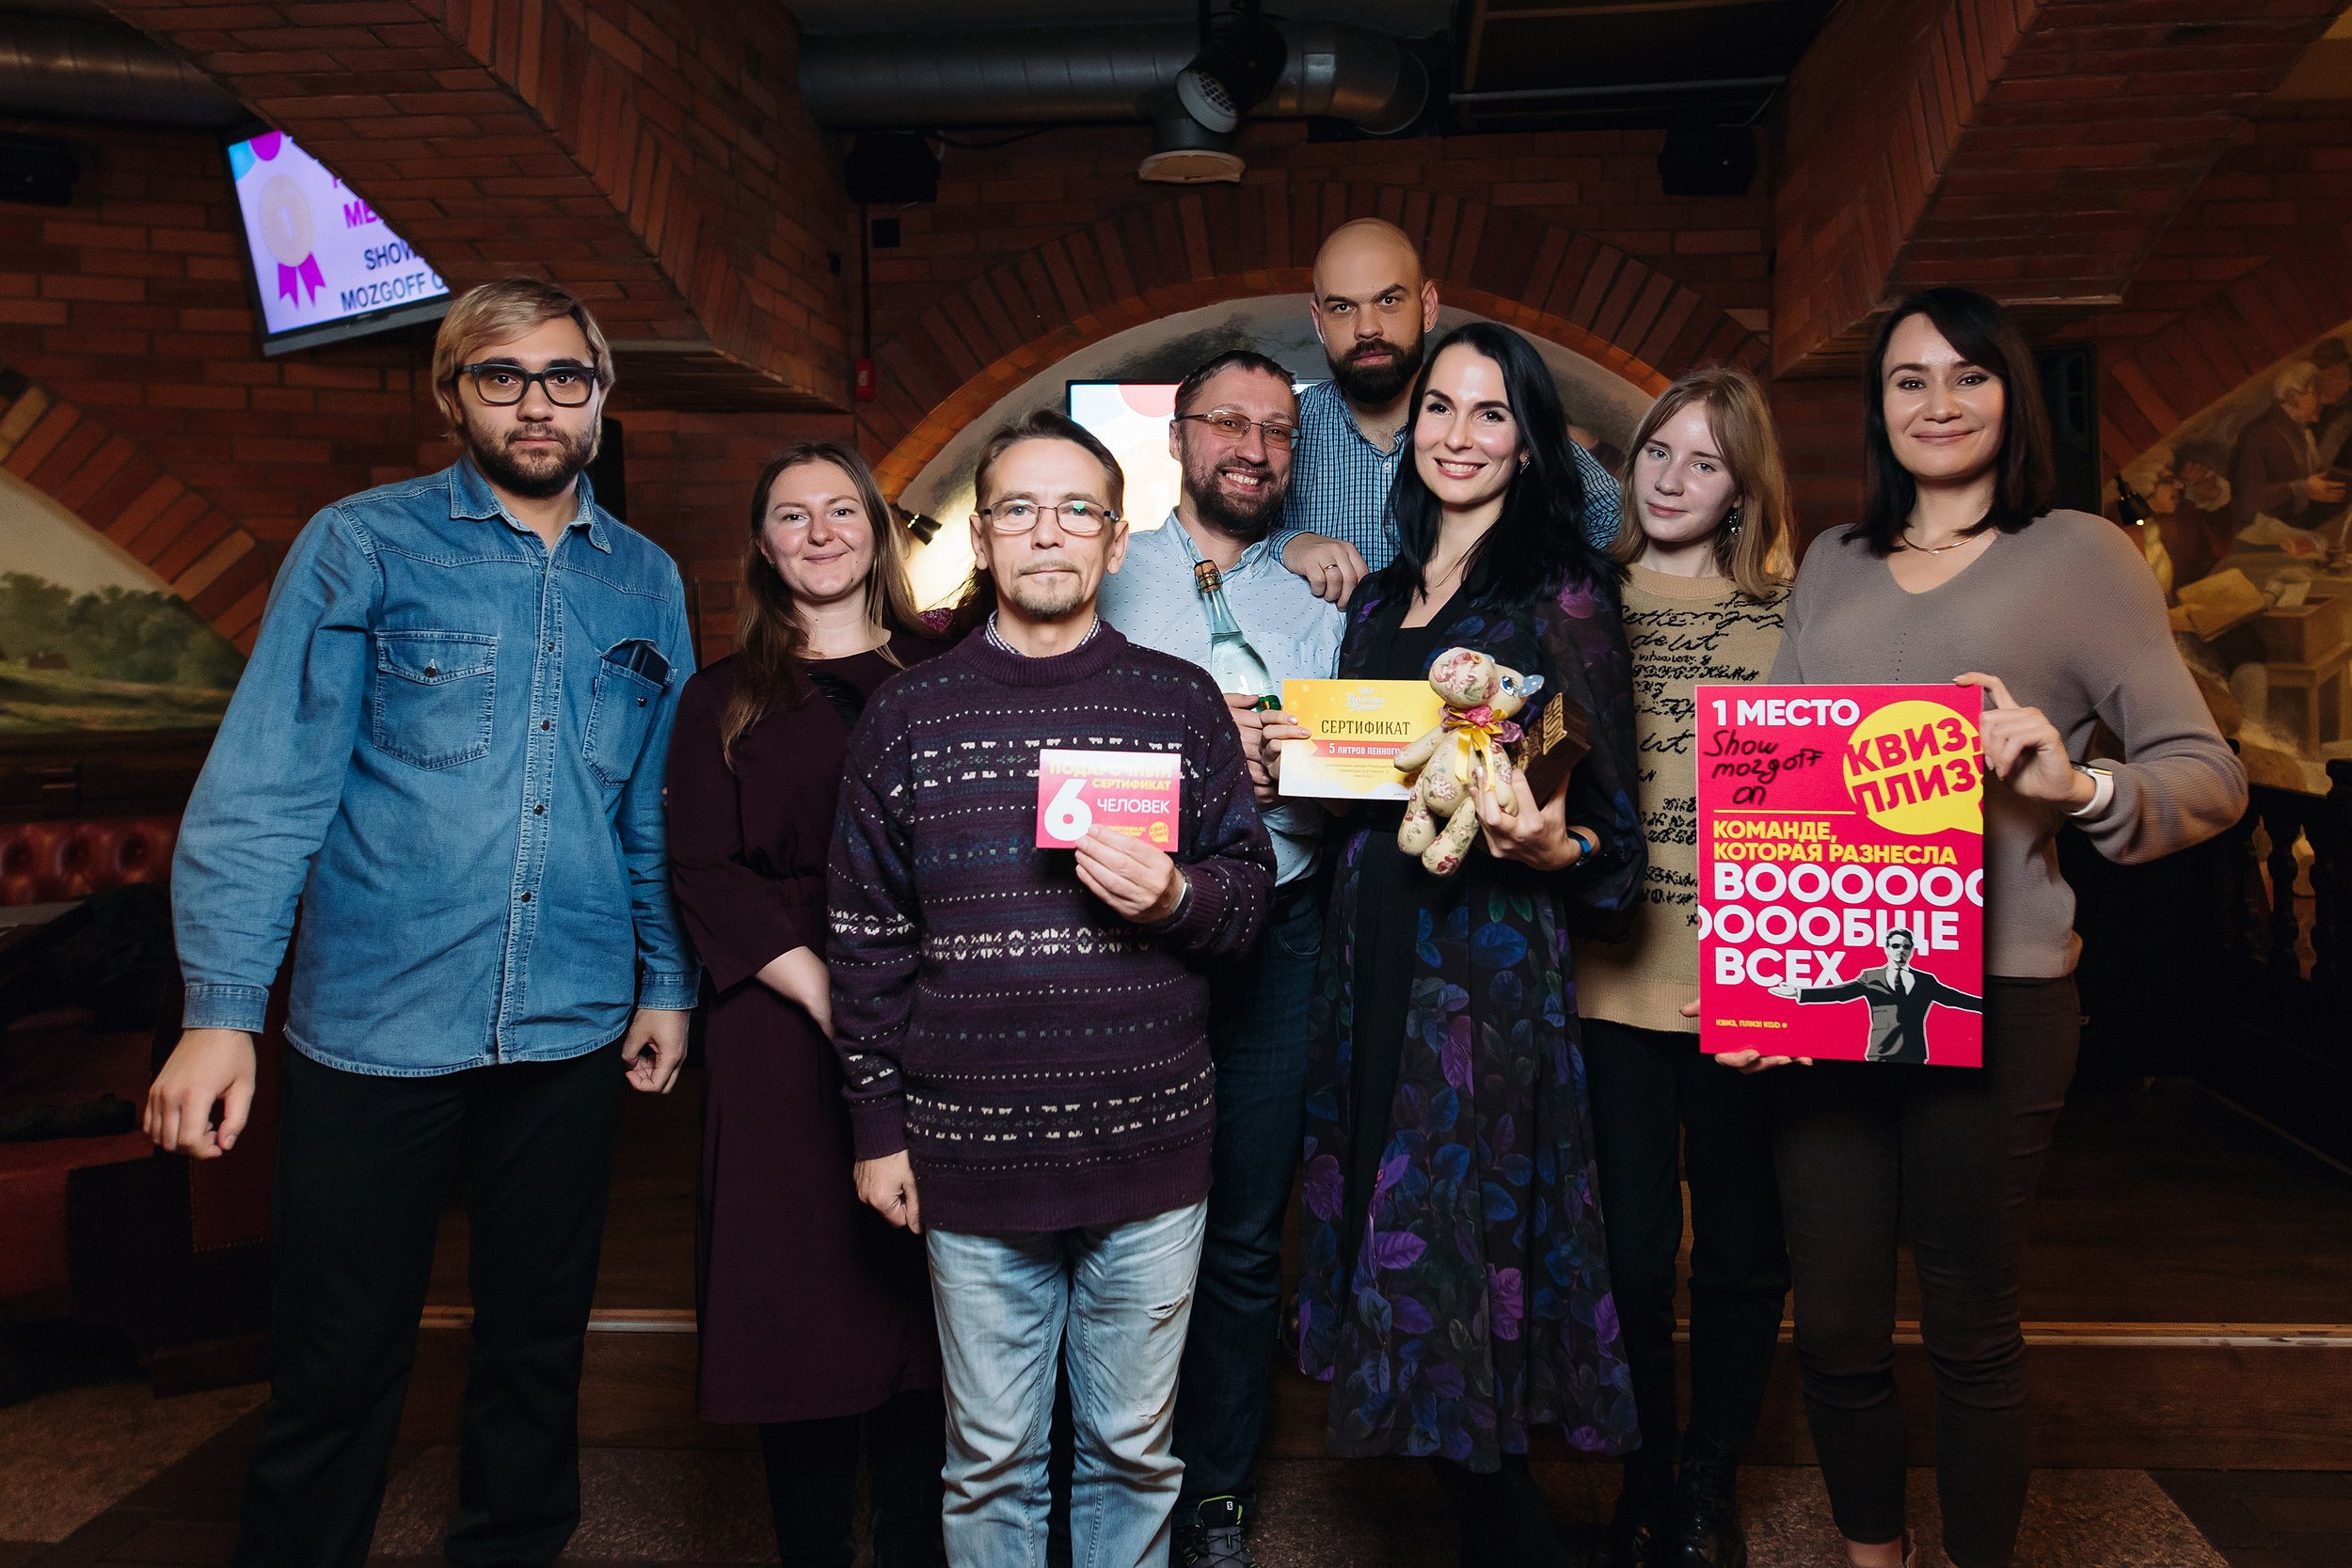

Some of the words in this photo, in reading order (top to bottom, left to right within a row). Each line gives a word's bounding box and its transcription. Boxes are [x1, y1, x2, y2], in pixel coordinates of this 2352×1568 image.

[340, 272, 425, 311] MOZGOFF
[1712, 699, 1726, 726] 1
[1737, 698, 1861, 726] МЕСТО
[1321, 719, 1411, 736] СЕРТИФИКАТ
[1328, 742, 1336, 754] 5
[1703, 729, 1781, 757] Show
[1711, 748, 1825, 784] mozgoff
[1091, 778, 1173, 791] СЕРТИФИКАТ
[1732, 785, 1767, 806] on
[1043, 778, 1093, 842] 6
[1096, 797, 1171, 814] ЧЕЛОВЕК
[1712, 819, 1837, 844] КОМАНДЕ,
[1712, 842, 1823, 863] КОТОРАЯ
[1829, 843, 1959, 865] РАЗНЕСЛА
[1714, 946, 1847, 988] ВСЕХ
